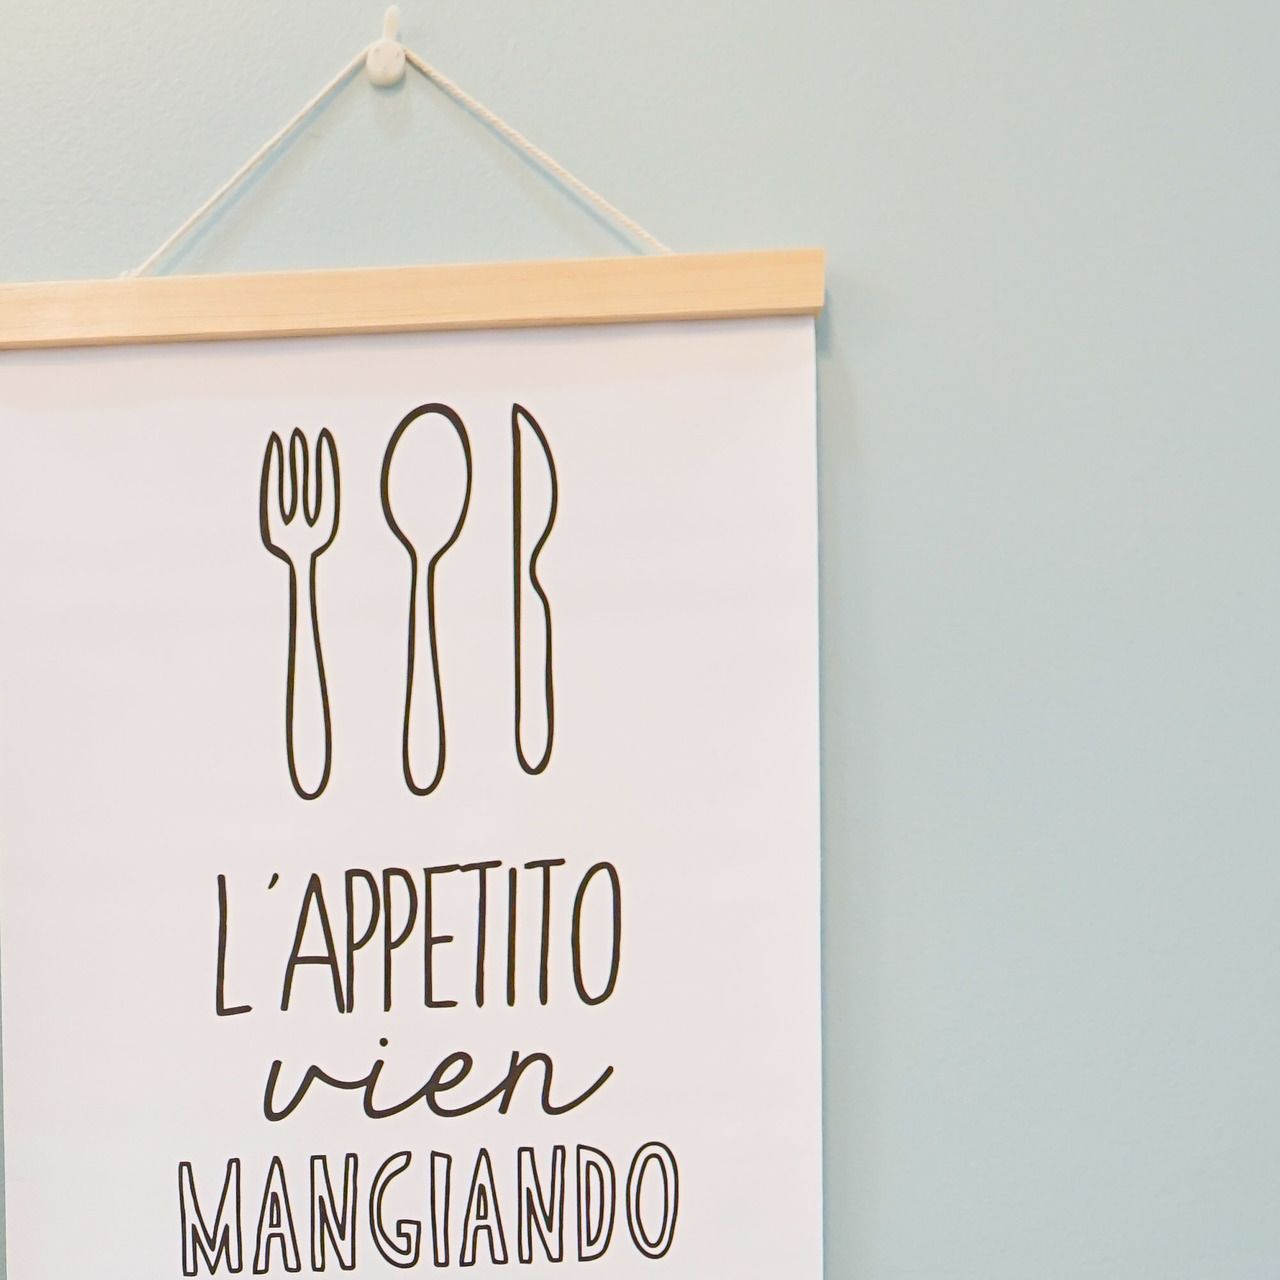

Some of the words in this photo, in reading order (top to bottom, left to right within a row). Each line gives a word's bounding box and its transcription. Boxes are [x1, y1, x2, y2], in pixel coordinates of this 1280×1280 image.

[216, 859, 621, 1016] L'APPETITO
[264, 1038, 613, 1121] vien
[179, 1142, 679, 1277] MANGIANDO
